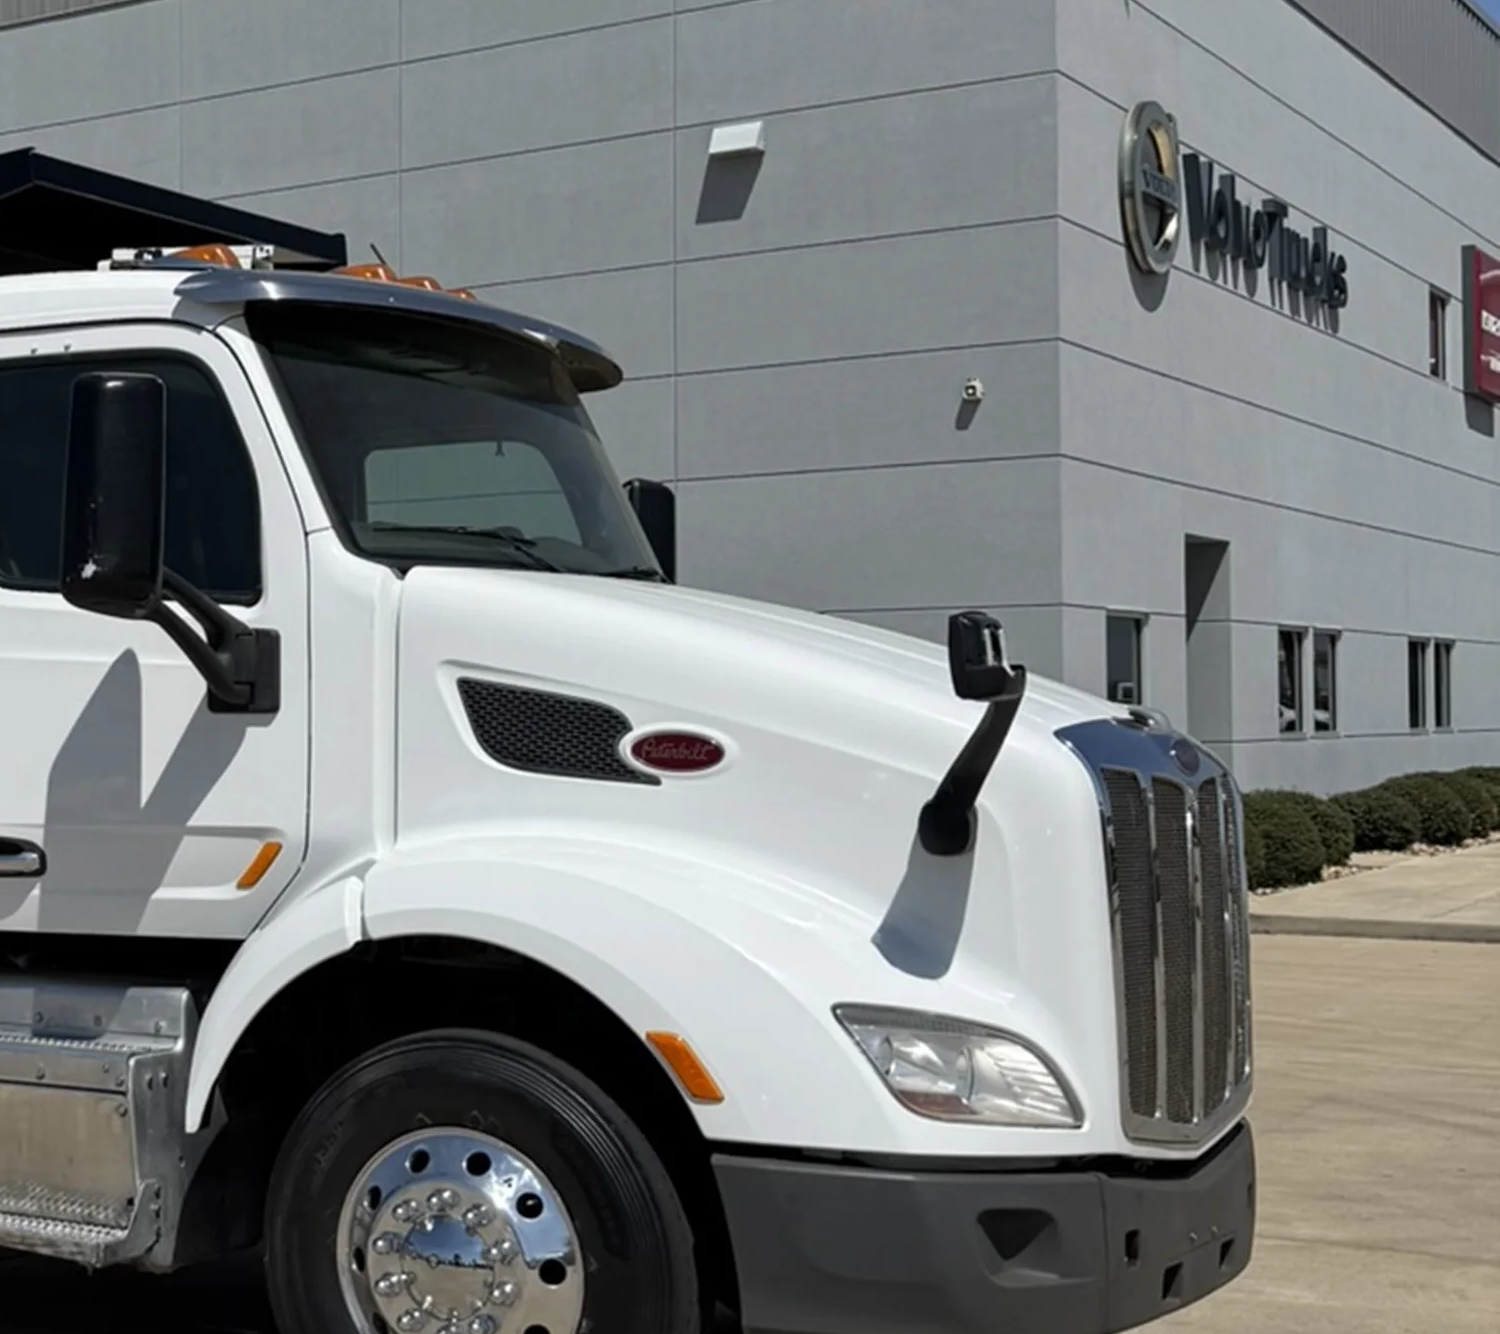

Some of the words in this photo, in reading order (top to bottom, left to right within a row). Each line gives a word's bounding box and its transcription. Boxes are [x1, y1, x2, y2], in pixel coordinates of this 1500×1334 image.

[1183, 153, 1267, 269] Volvo
[1262, 198, 1348, 308] Trucks
[642, 738, 715, 760] Peterbilt
